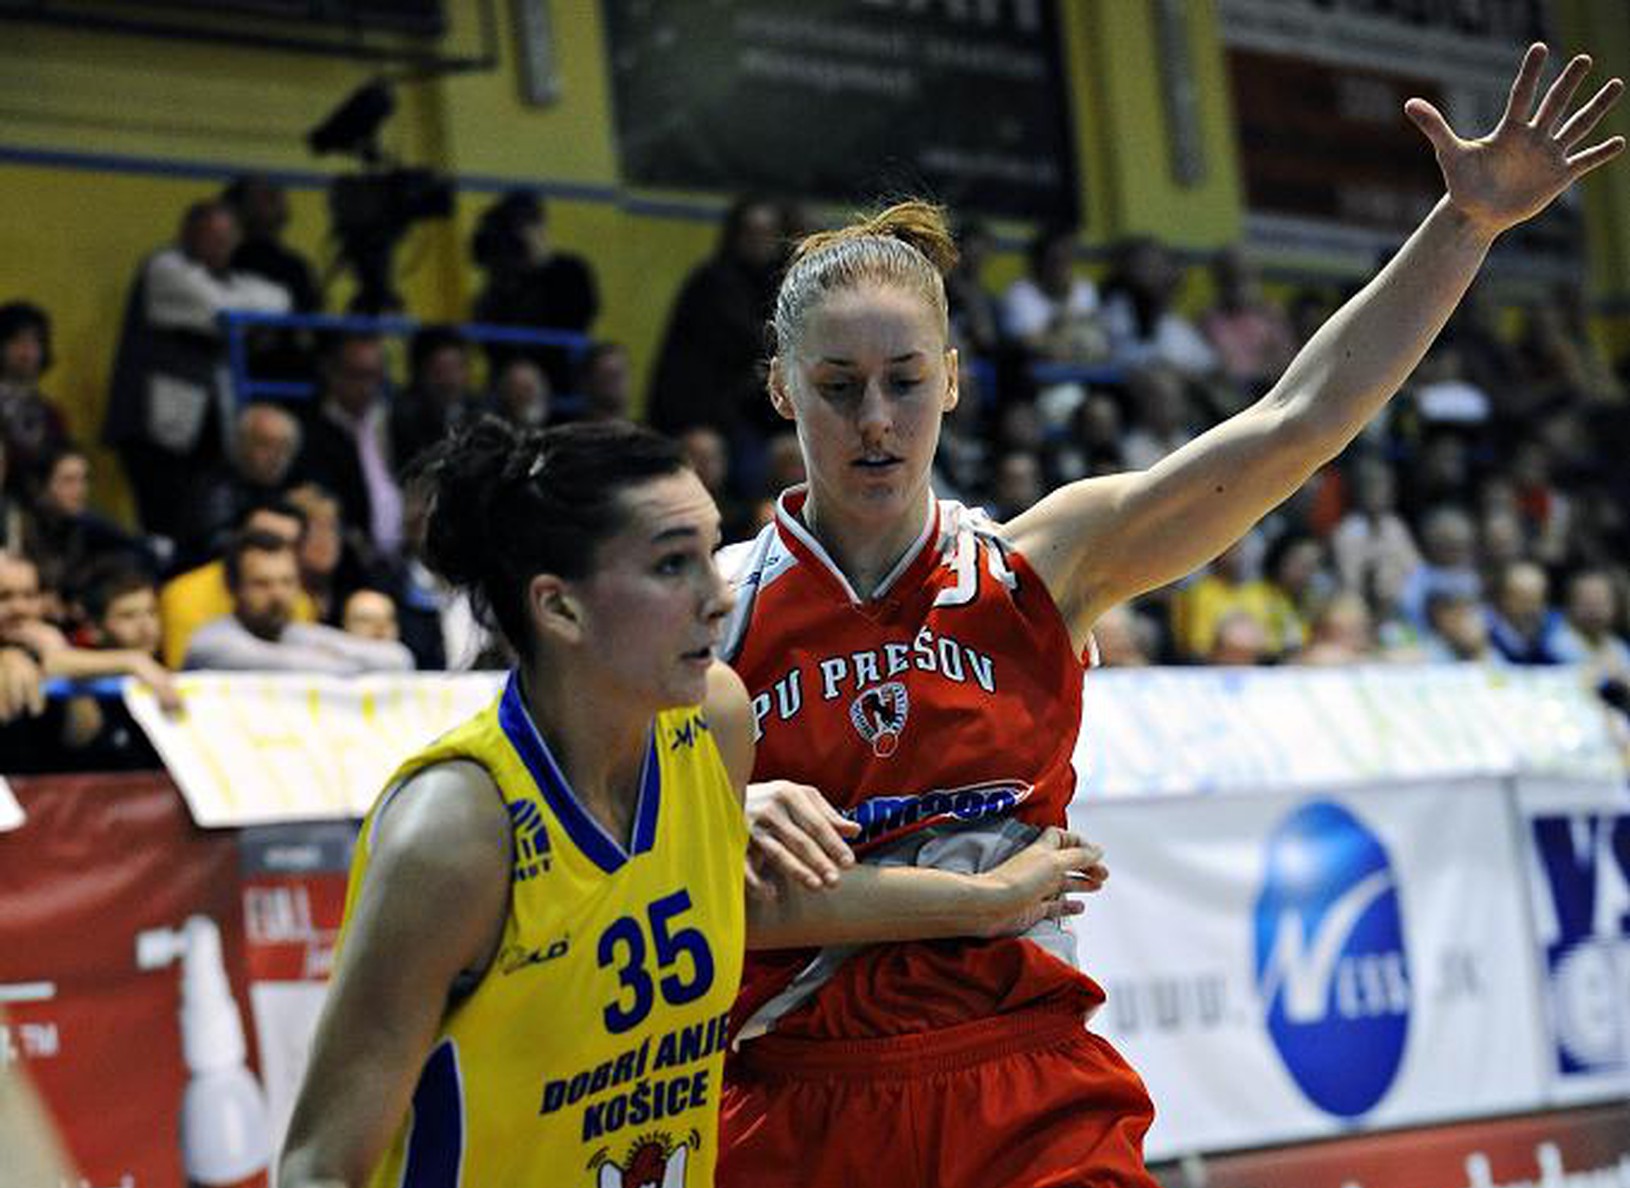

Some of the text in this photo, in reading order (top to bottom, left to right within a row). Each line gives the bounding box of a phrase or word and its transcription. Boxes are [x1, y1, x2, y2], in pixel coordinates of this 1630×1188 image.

[596, 887, 715, 1035] 35
[539, 1034, 650, 1116] DOBRÍ
[581, 1068, 709, 1143] KOŠICE
